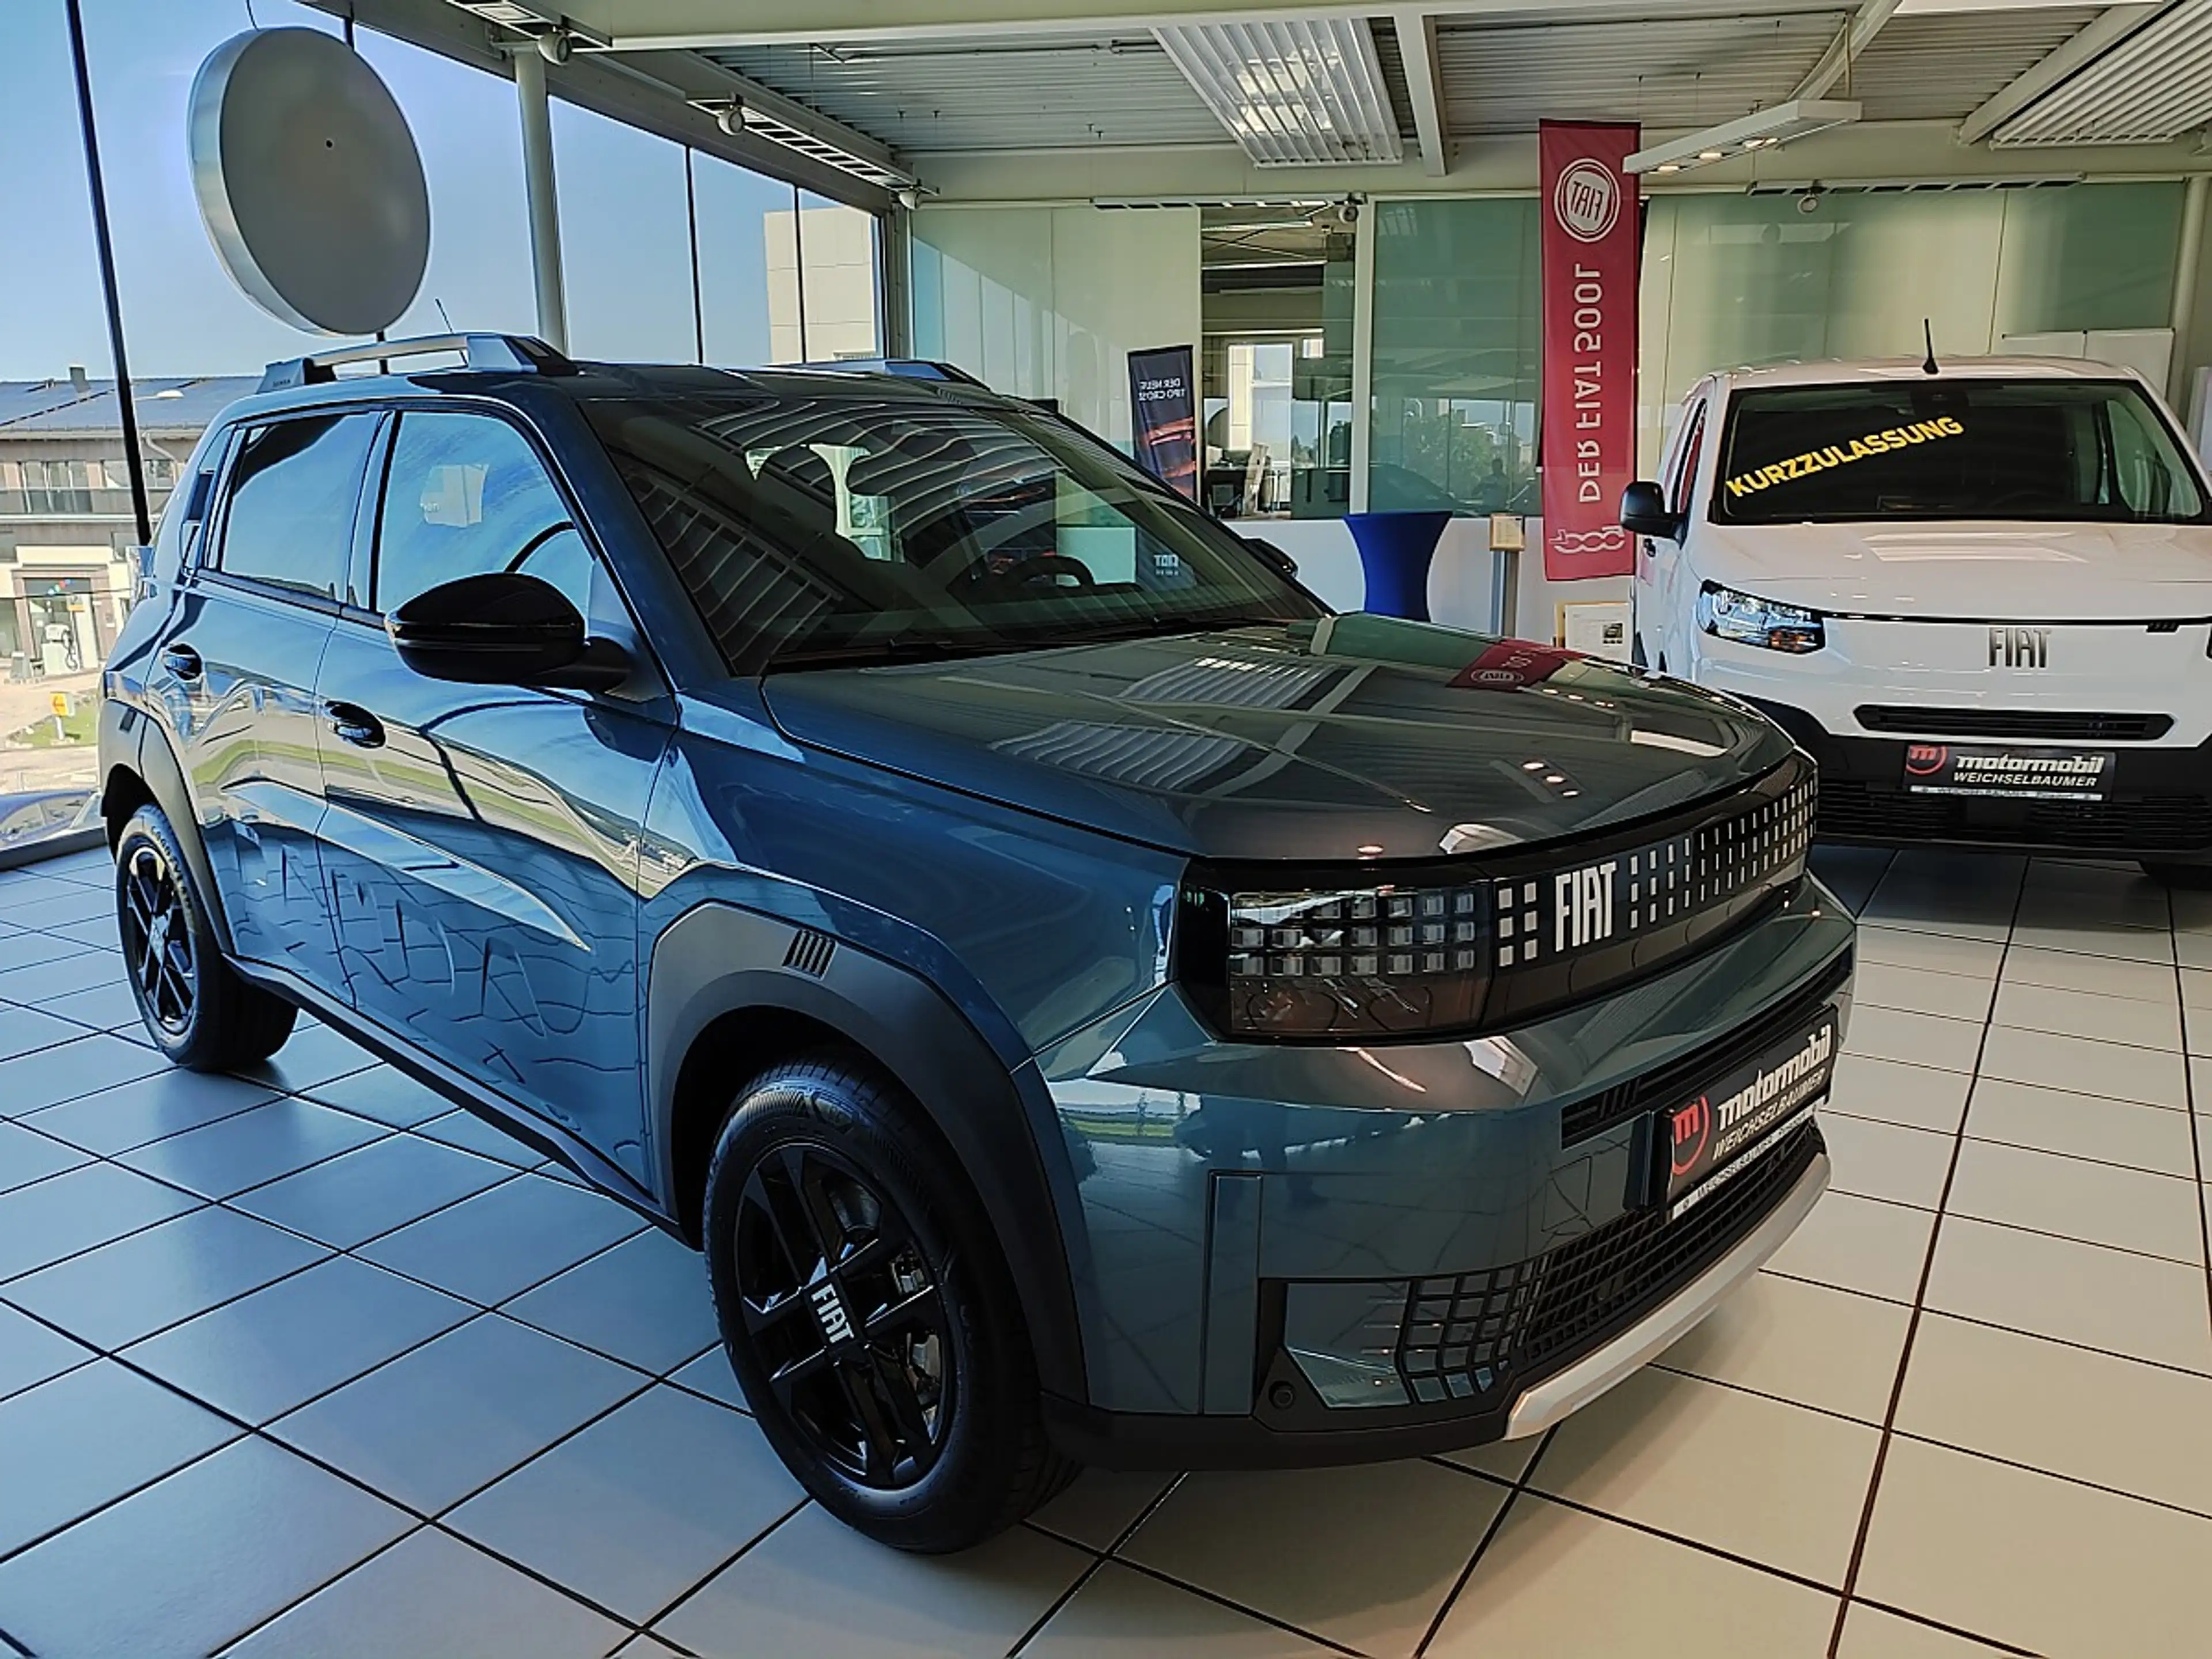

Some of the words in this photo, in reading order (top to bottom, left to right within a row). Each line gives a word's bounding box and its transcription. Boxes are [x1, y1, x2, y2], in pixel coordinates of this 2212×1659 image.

[1726, 416, 1964, 497] KURZZULASSUNG
[1988, 627, 2052, 668] FIAT
[1953, 772, 2097, 787] WEICHSELBAUMER
[1956, 753, 2105, 774] motormobil
[1555, 860, 1616, 952] FIAT
[1717, 1024, 1832, 1131] motormobil
[1712, 1067, 1825, 1161] WEICHSELBAUMER
[811, 1283, 854, 1343] FIAT
